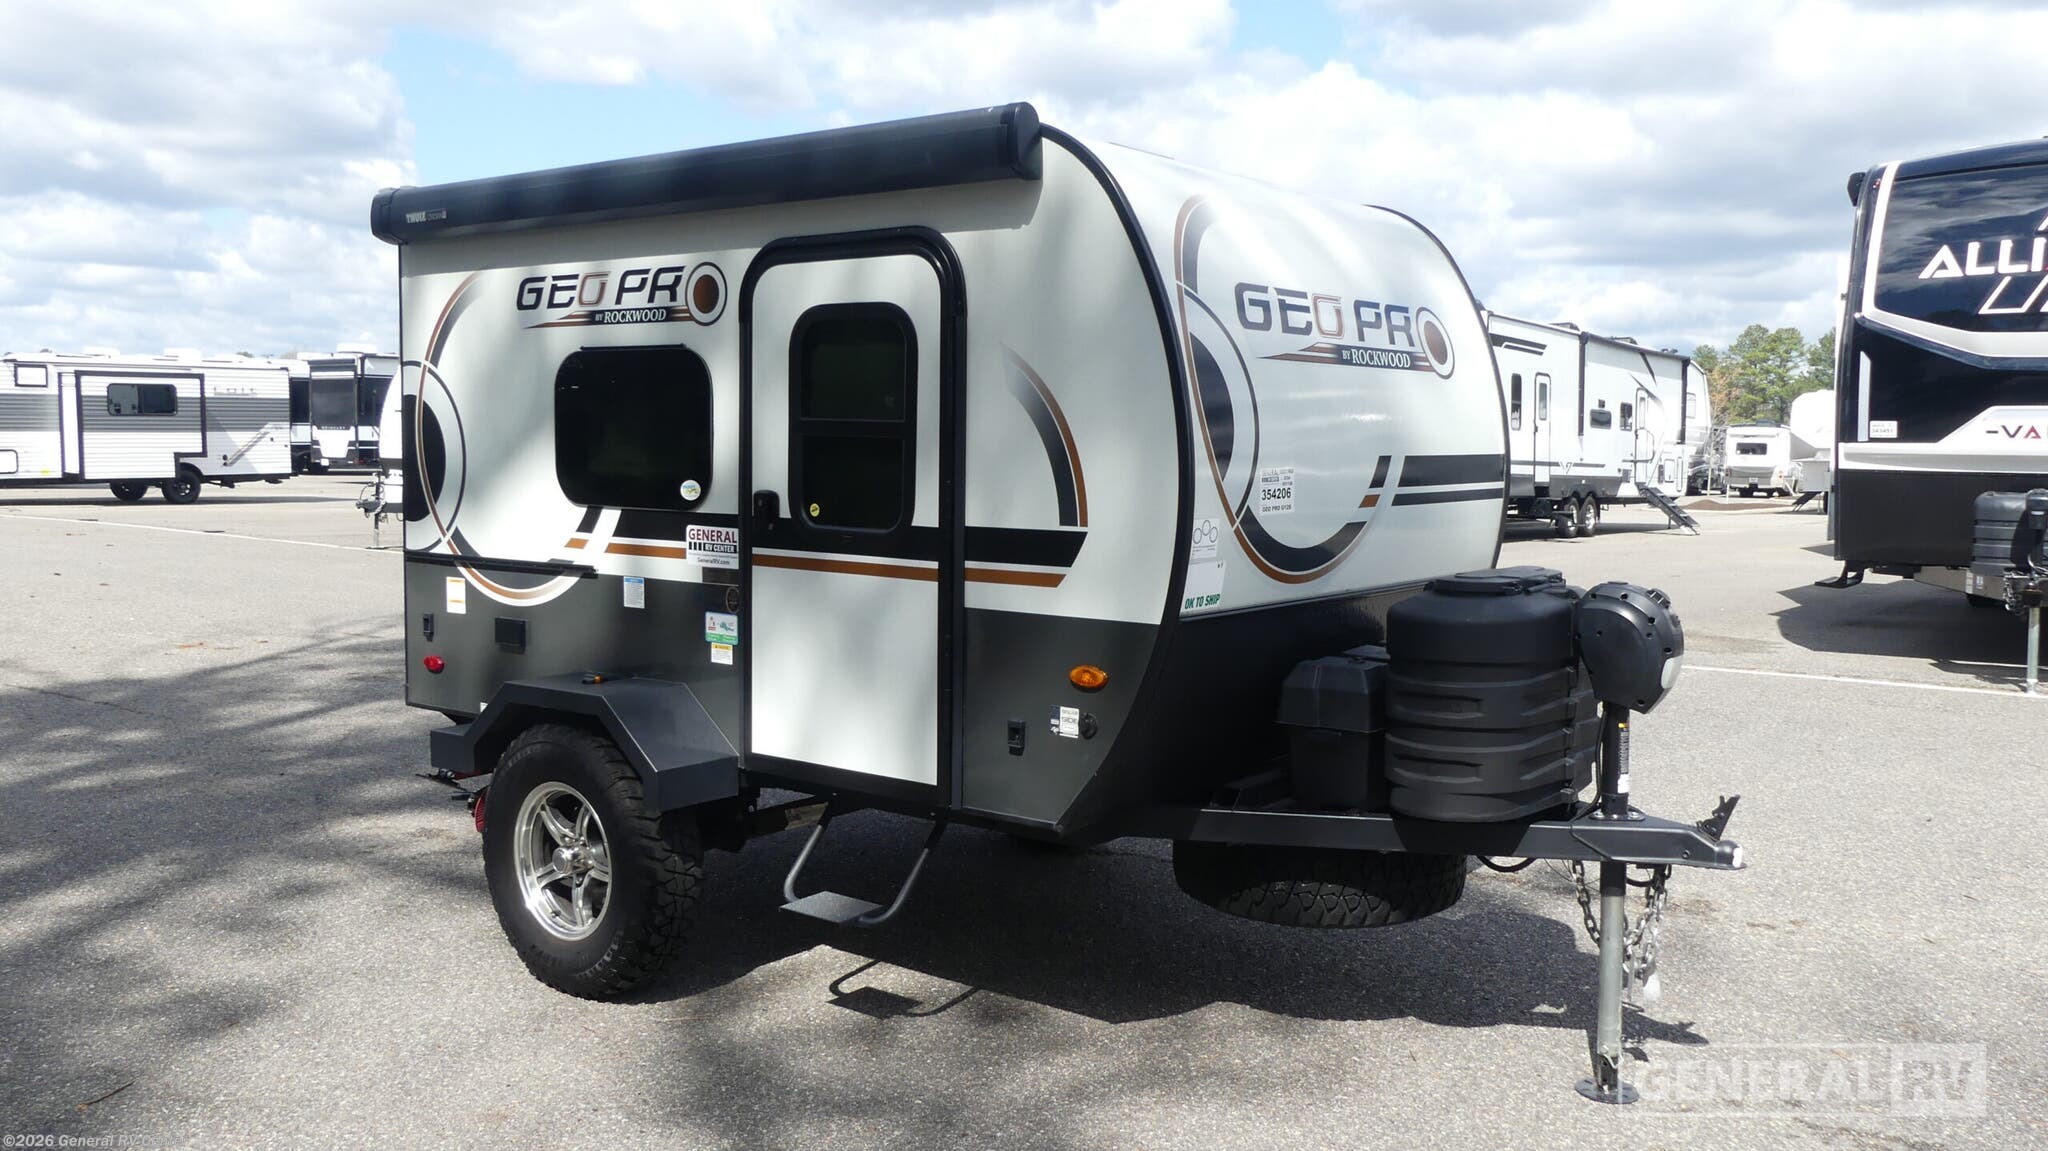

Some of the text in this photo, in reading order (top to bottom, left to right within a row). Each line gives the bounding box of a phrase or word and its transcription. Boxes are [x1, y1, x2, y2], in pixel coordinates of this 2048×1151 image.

[1918, 237, 2048, 279] ALLI
[516, 261, 728, 326] GEO PRO
[603, 308, 667, 324] ROCKWOOD
[1235, 282, 1455, 380] GEO PRO
[1342, 347, 1411, 369] BY ROCKWOOD
[2001, 425, 2048, 439] VA
[1261, 487, 1292, 500] 354206
[688, 528, 737, 544] GENERAL
[713, 544, 735, 553] CENTER
[1185, 593, 1220, 609] OK TO SHIP
